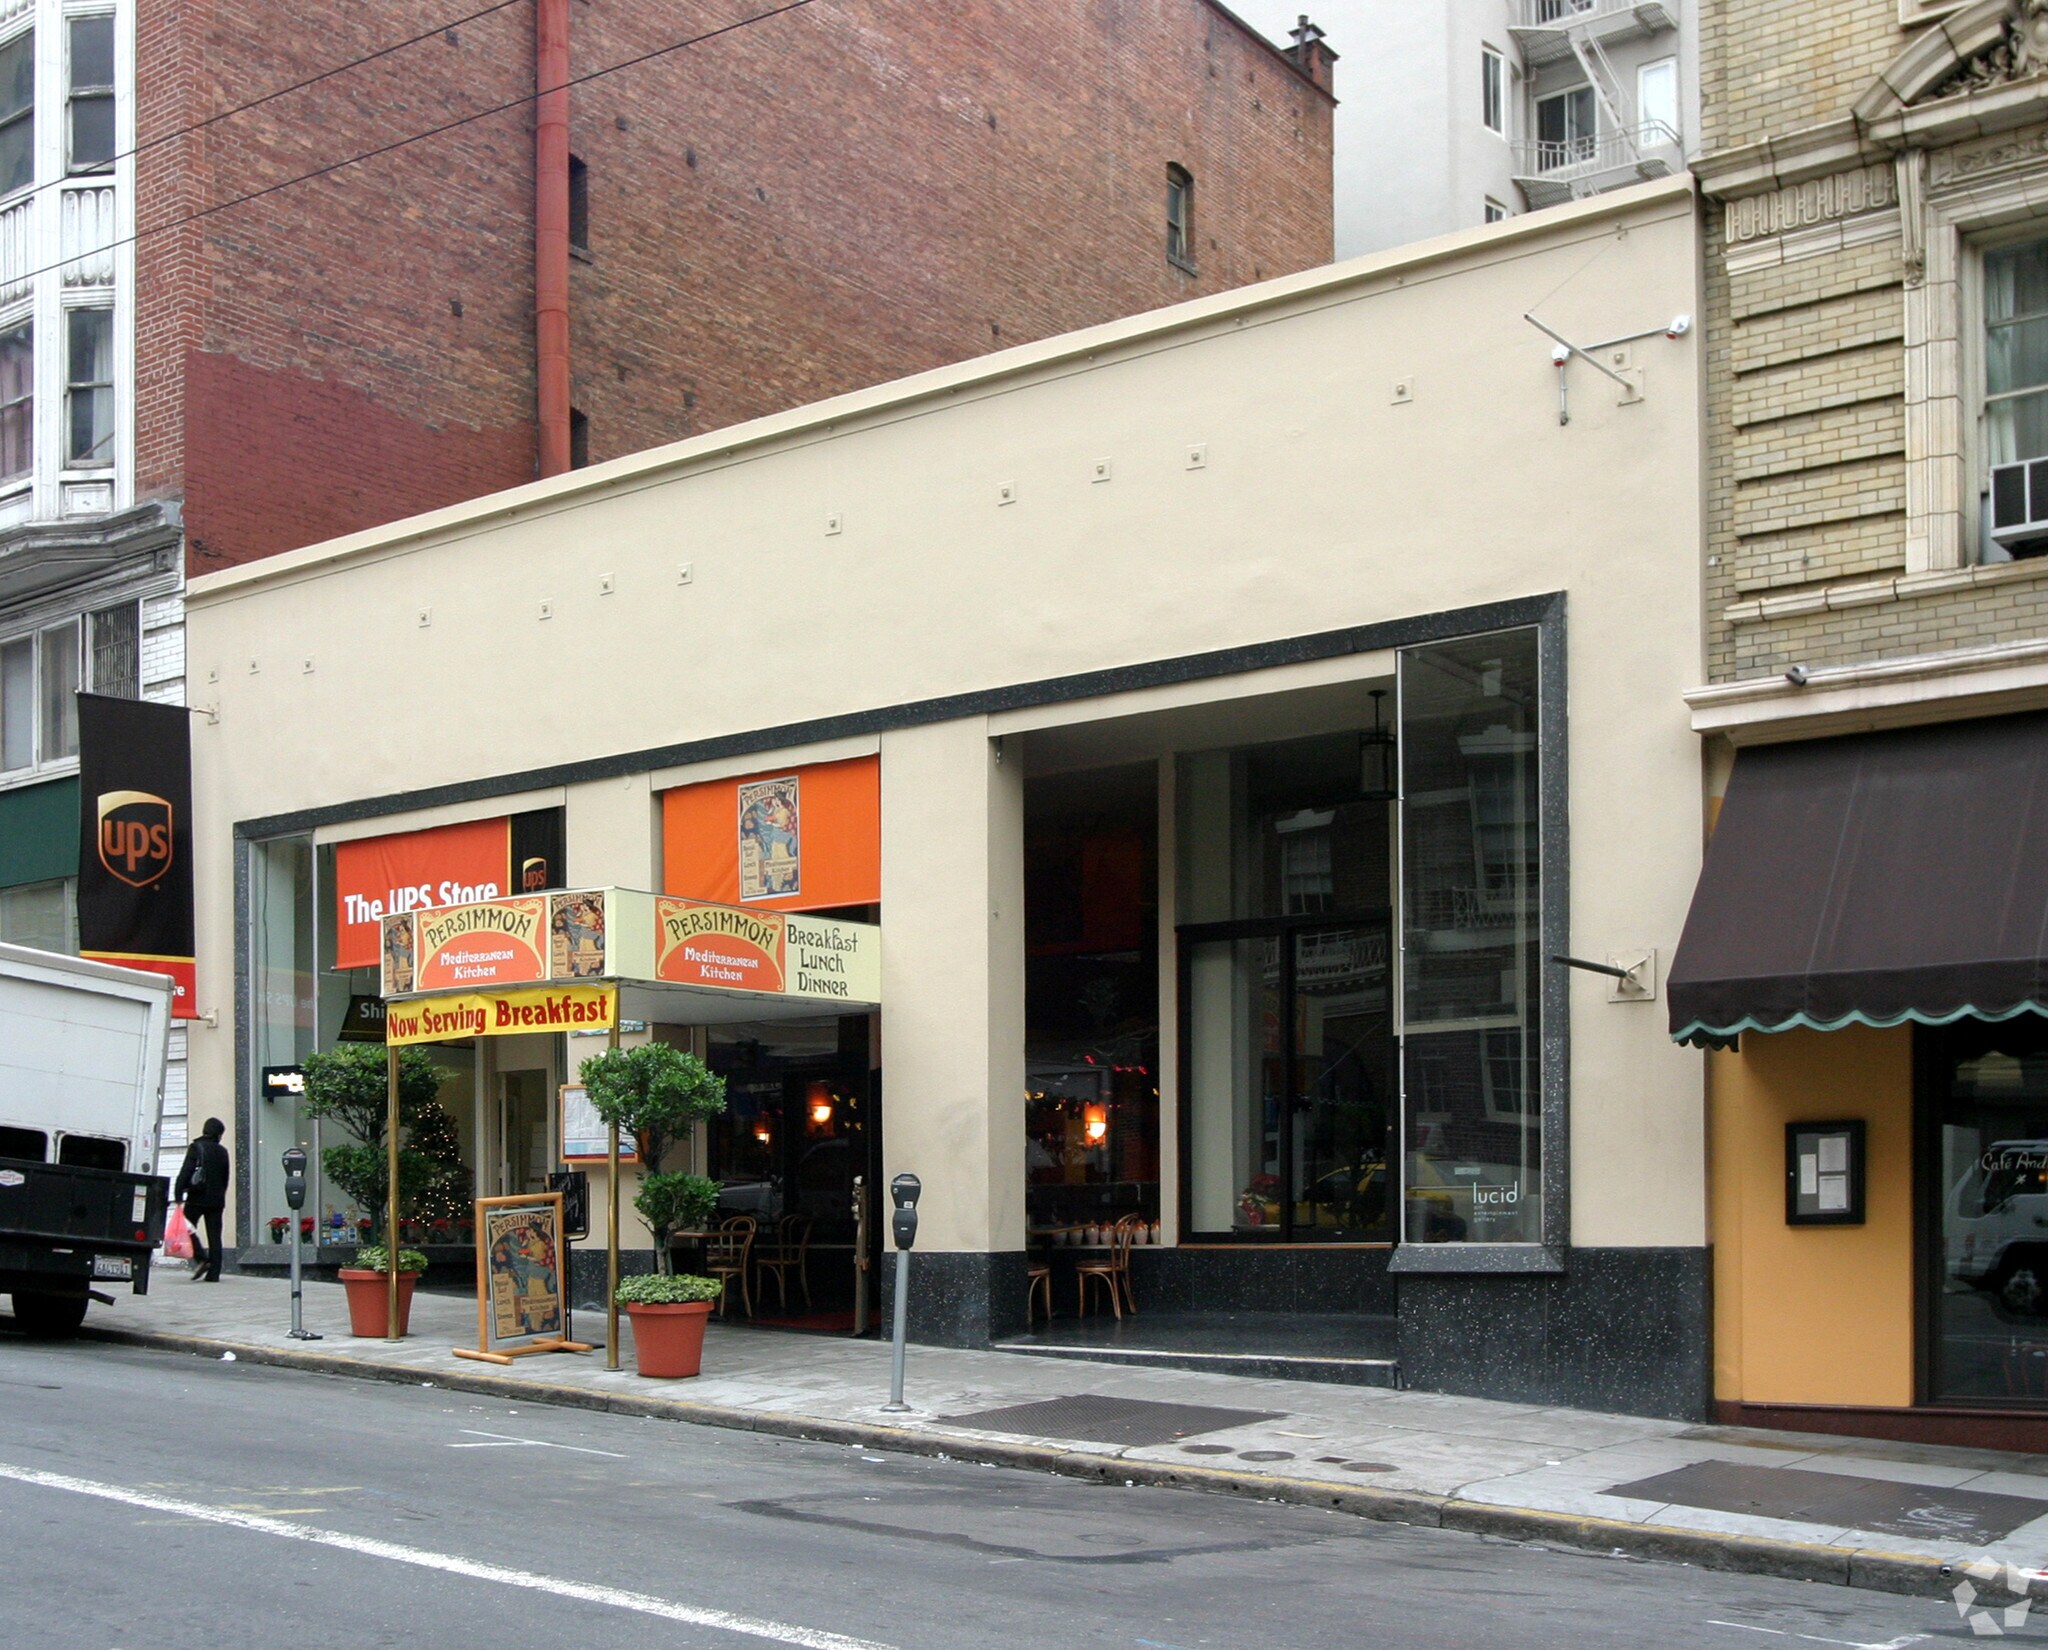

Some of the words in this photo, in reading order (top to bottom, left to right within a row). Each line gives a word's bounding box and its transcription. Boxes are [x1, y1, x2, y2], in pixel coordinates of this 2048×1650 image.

[104, 819, 168, 872] ups
[344, 892, 383, 925] The
[389, 884, 432, 915] UPS
[438, 881, 499, 906] Store
[426, 908, 531, 948] PERSIMMON
[666, 911, 773, 950] PERSIMMON
[787, 924, 858, 953] Breakfast
[440, 949, 514, 967] Mediterranean
[684, 947, 759, 968] Mediterranean
[800, 948, 845, 973] Lunch
[454, 964, 496, 980] Kitchen
[700, 964, 743, 981] Kitchen
[797, 971, 848, 997] Dinner
[388, 1012, 418, 1039] Now
[422, 1003, 486, 1034] Serving
[495, 995, 607, 1028] Breakfast
[1981, 1152, 2013, 1171] Café
[1473, 1181, 1518, 1204] lucid
